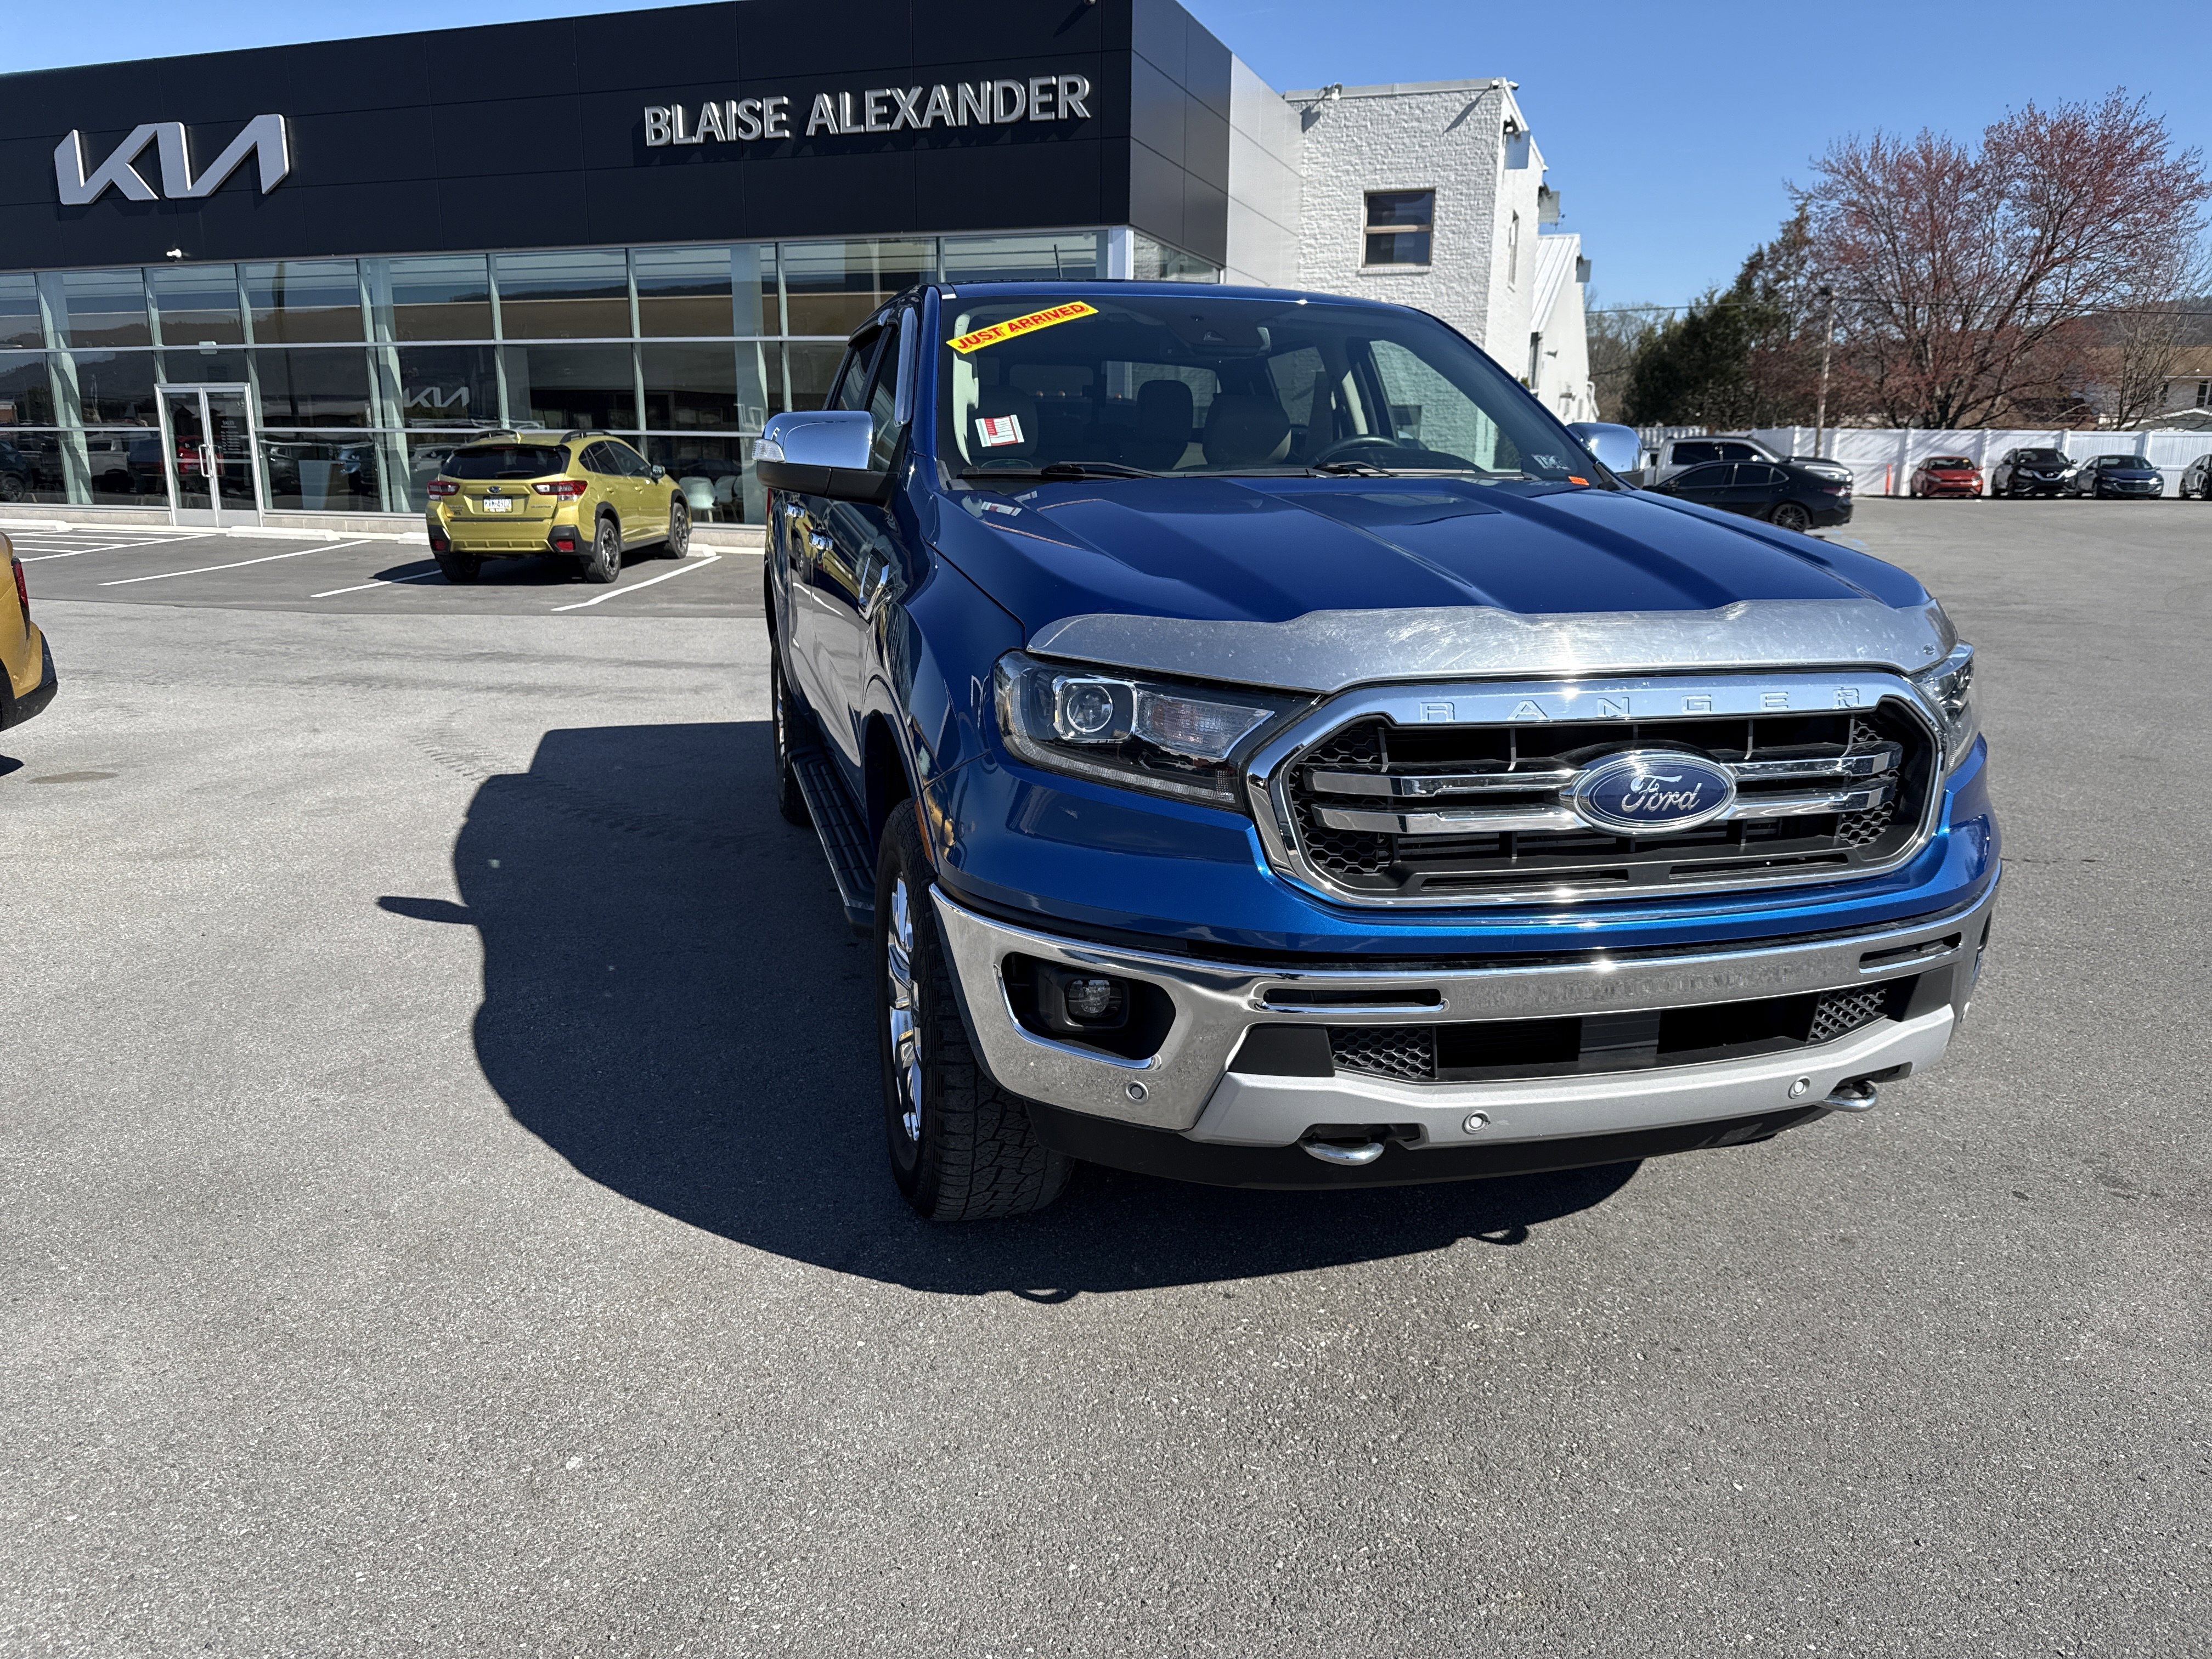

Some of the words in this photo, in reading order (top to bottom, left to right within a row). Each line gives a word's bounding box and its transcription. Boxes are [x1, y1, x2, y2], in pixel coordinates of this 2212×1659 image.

[644, 95, 791, 146] BLAISE
[805, 74, 1091, 137] ALEXANDER
[54, 114, 289, 205] KIA
[957, 326, 1005, 349] JUST
[1008, 304, 1089, 332] ARRIVED
[1419, 689, 1859, 721] RANGER
[1621, 774, 1701, 814] Ford
